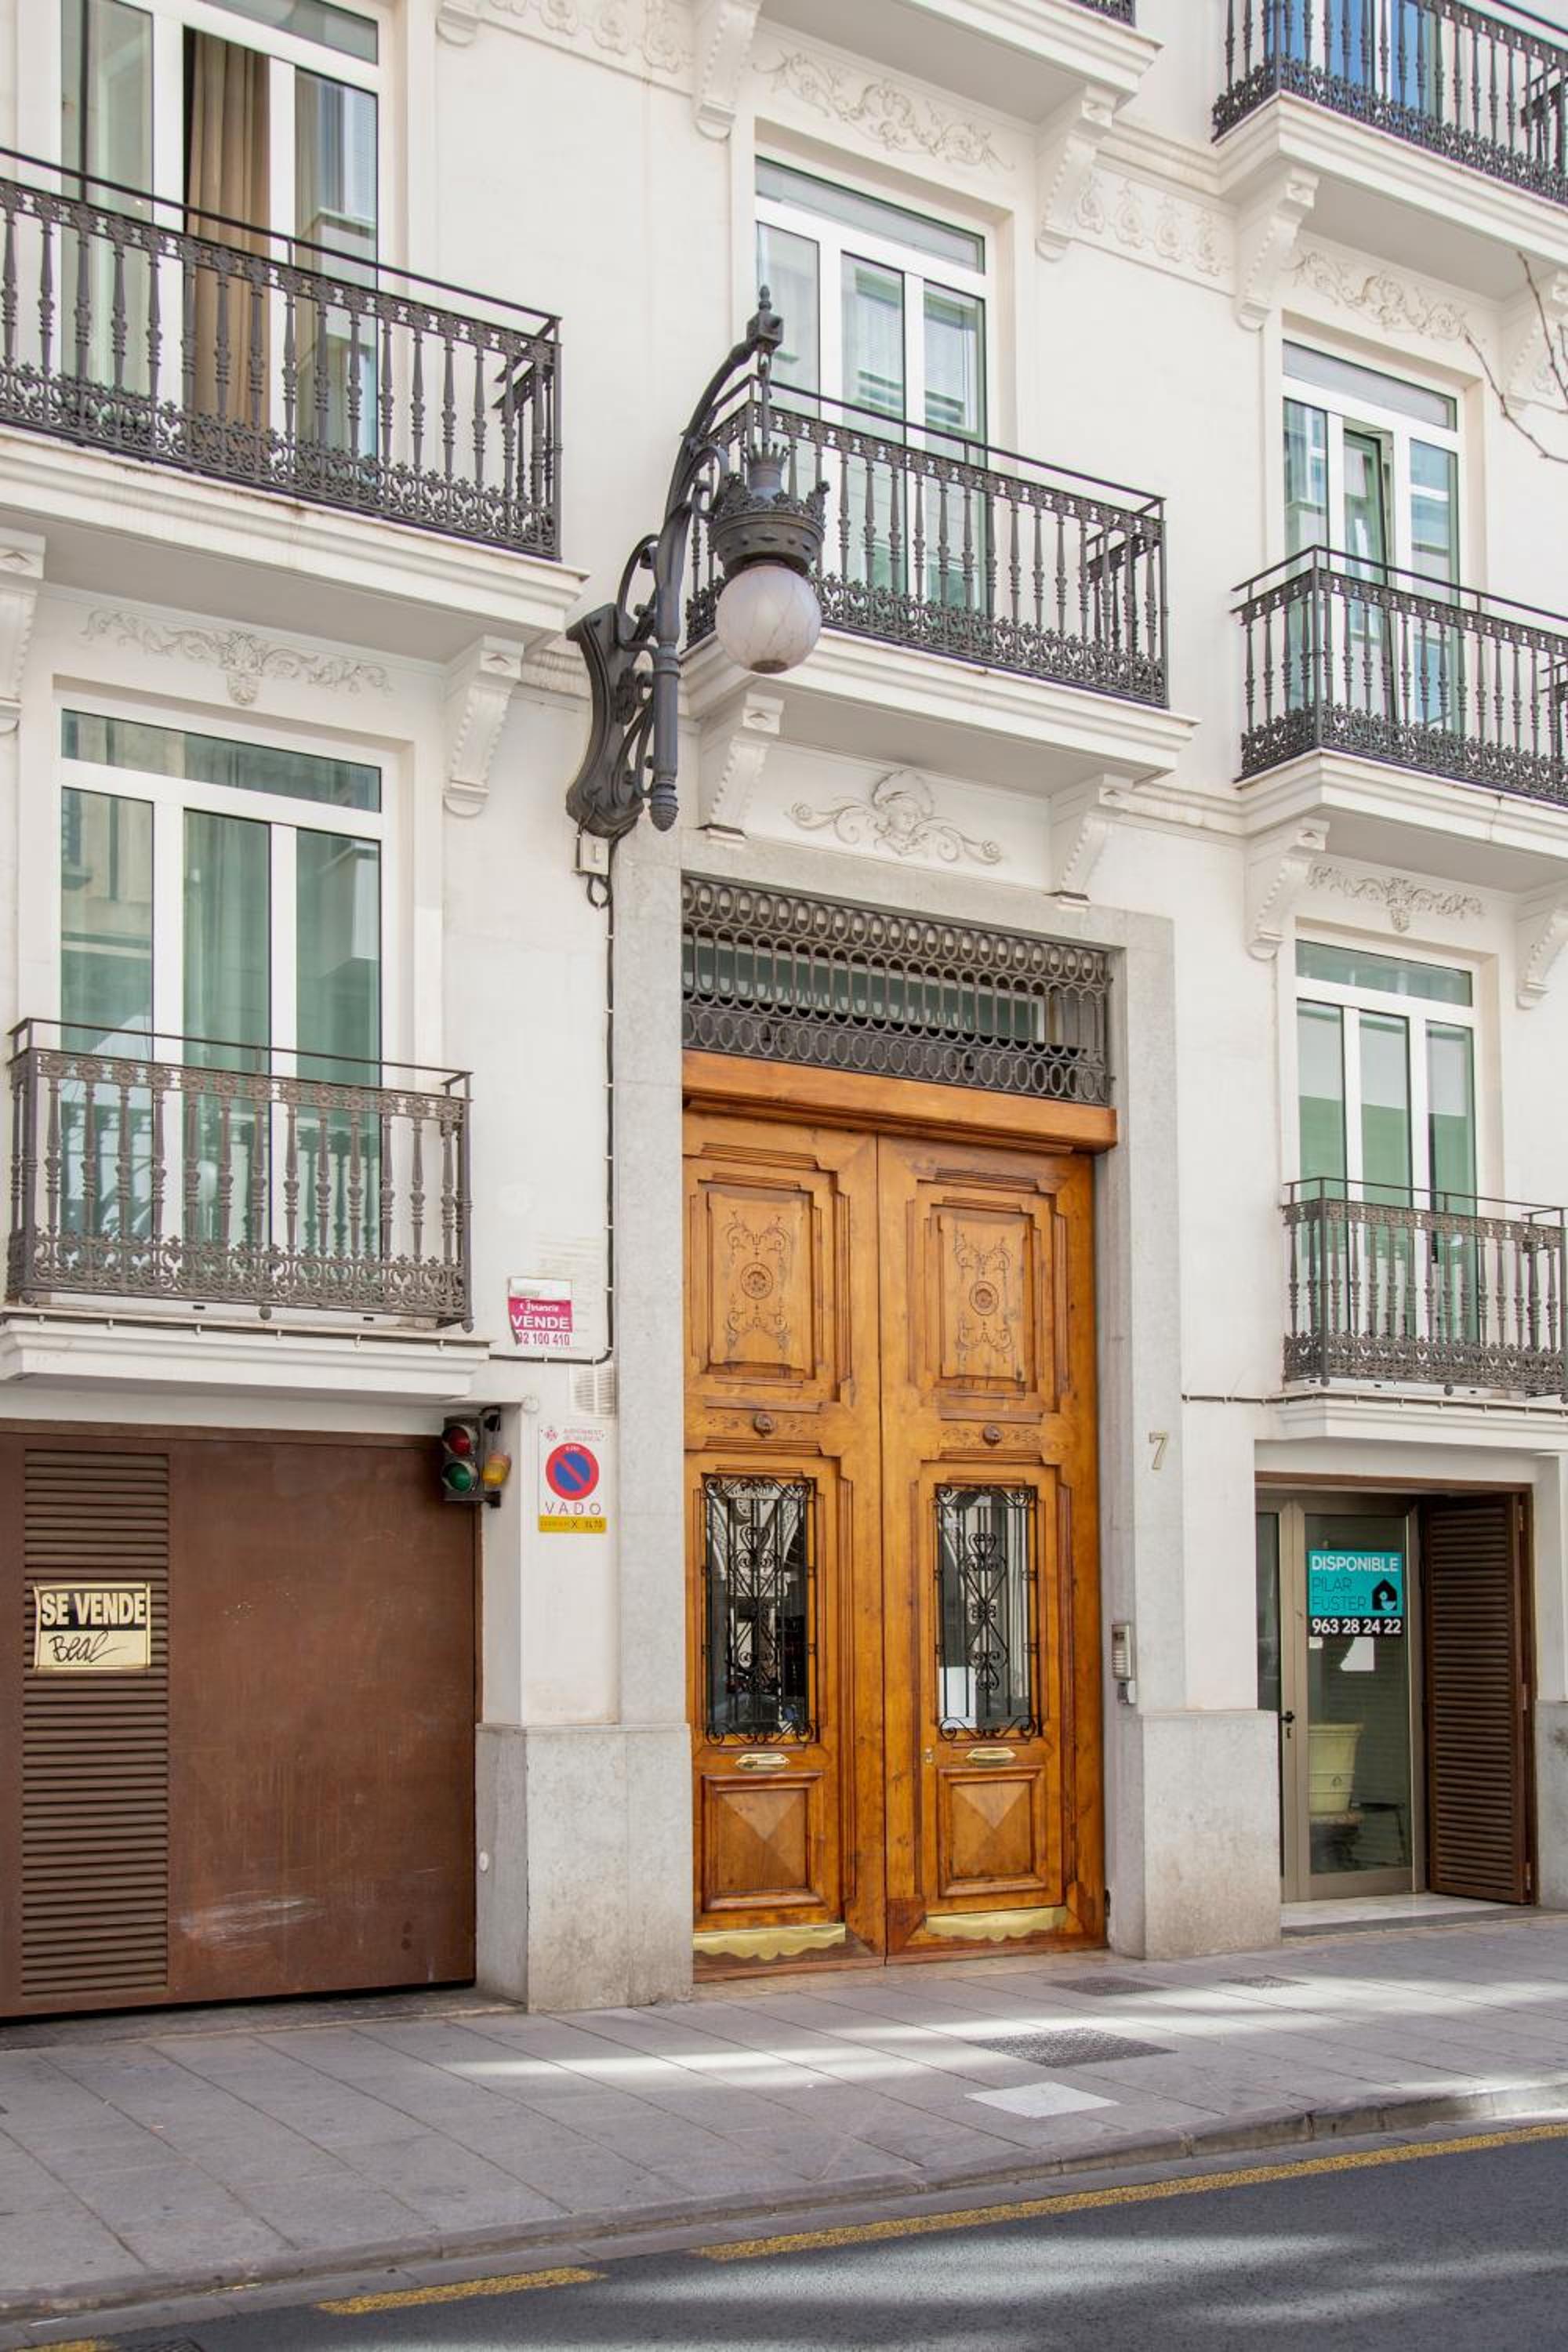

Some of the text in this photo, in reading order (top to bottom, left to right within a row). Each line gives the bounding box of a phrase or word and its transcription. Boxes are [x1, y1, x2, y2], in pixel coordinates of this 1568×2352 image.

[511, 1315, 570, 1329] VENDE
[533, 1333, 550, 1345] 100
[553, 1334, 570, 1346] 410
[1149, 1432, 1168, 1470] 7
[545, 1501, 601, 1515] VADO
[1312, 1555, 1399, 1572] DISPONIBLE
[1312, 1577, 1352, 1592] PILAR
[42, 1592, 146, 1626] SE VENDE
[1312, 1595, 1367, 1611] FUSTER
[1312, 1618, 1401, 1634] 963 28 24 22
